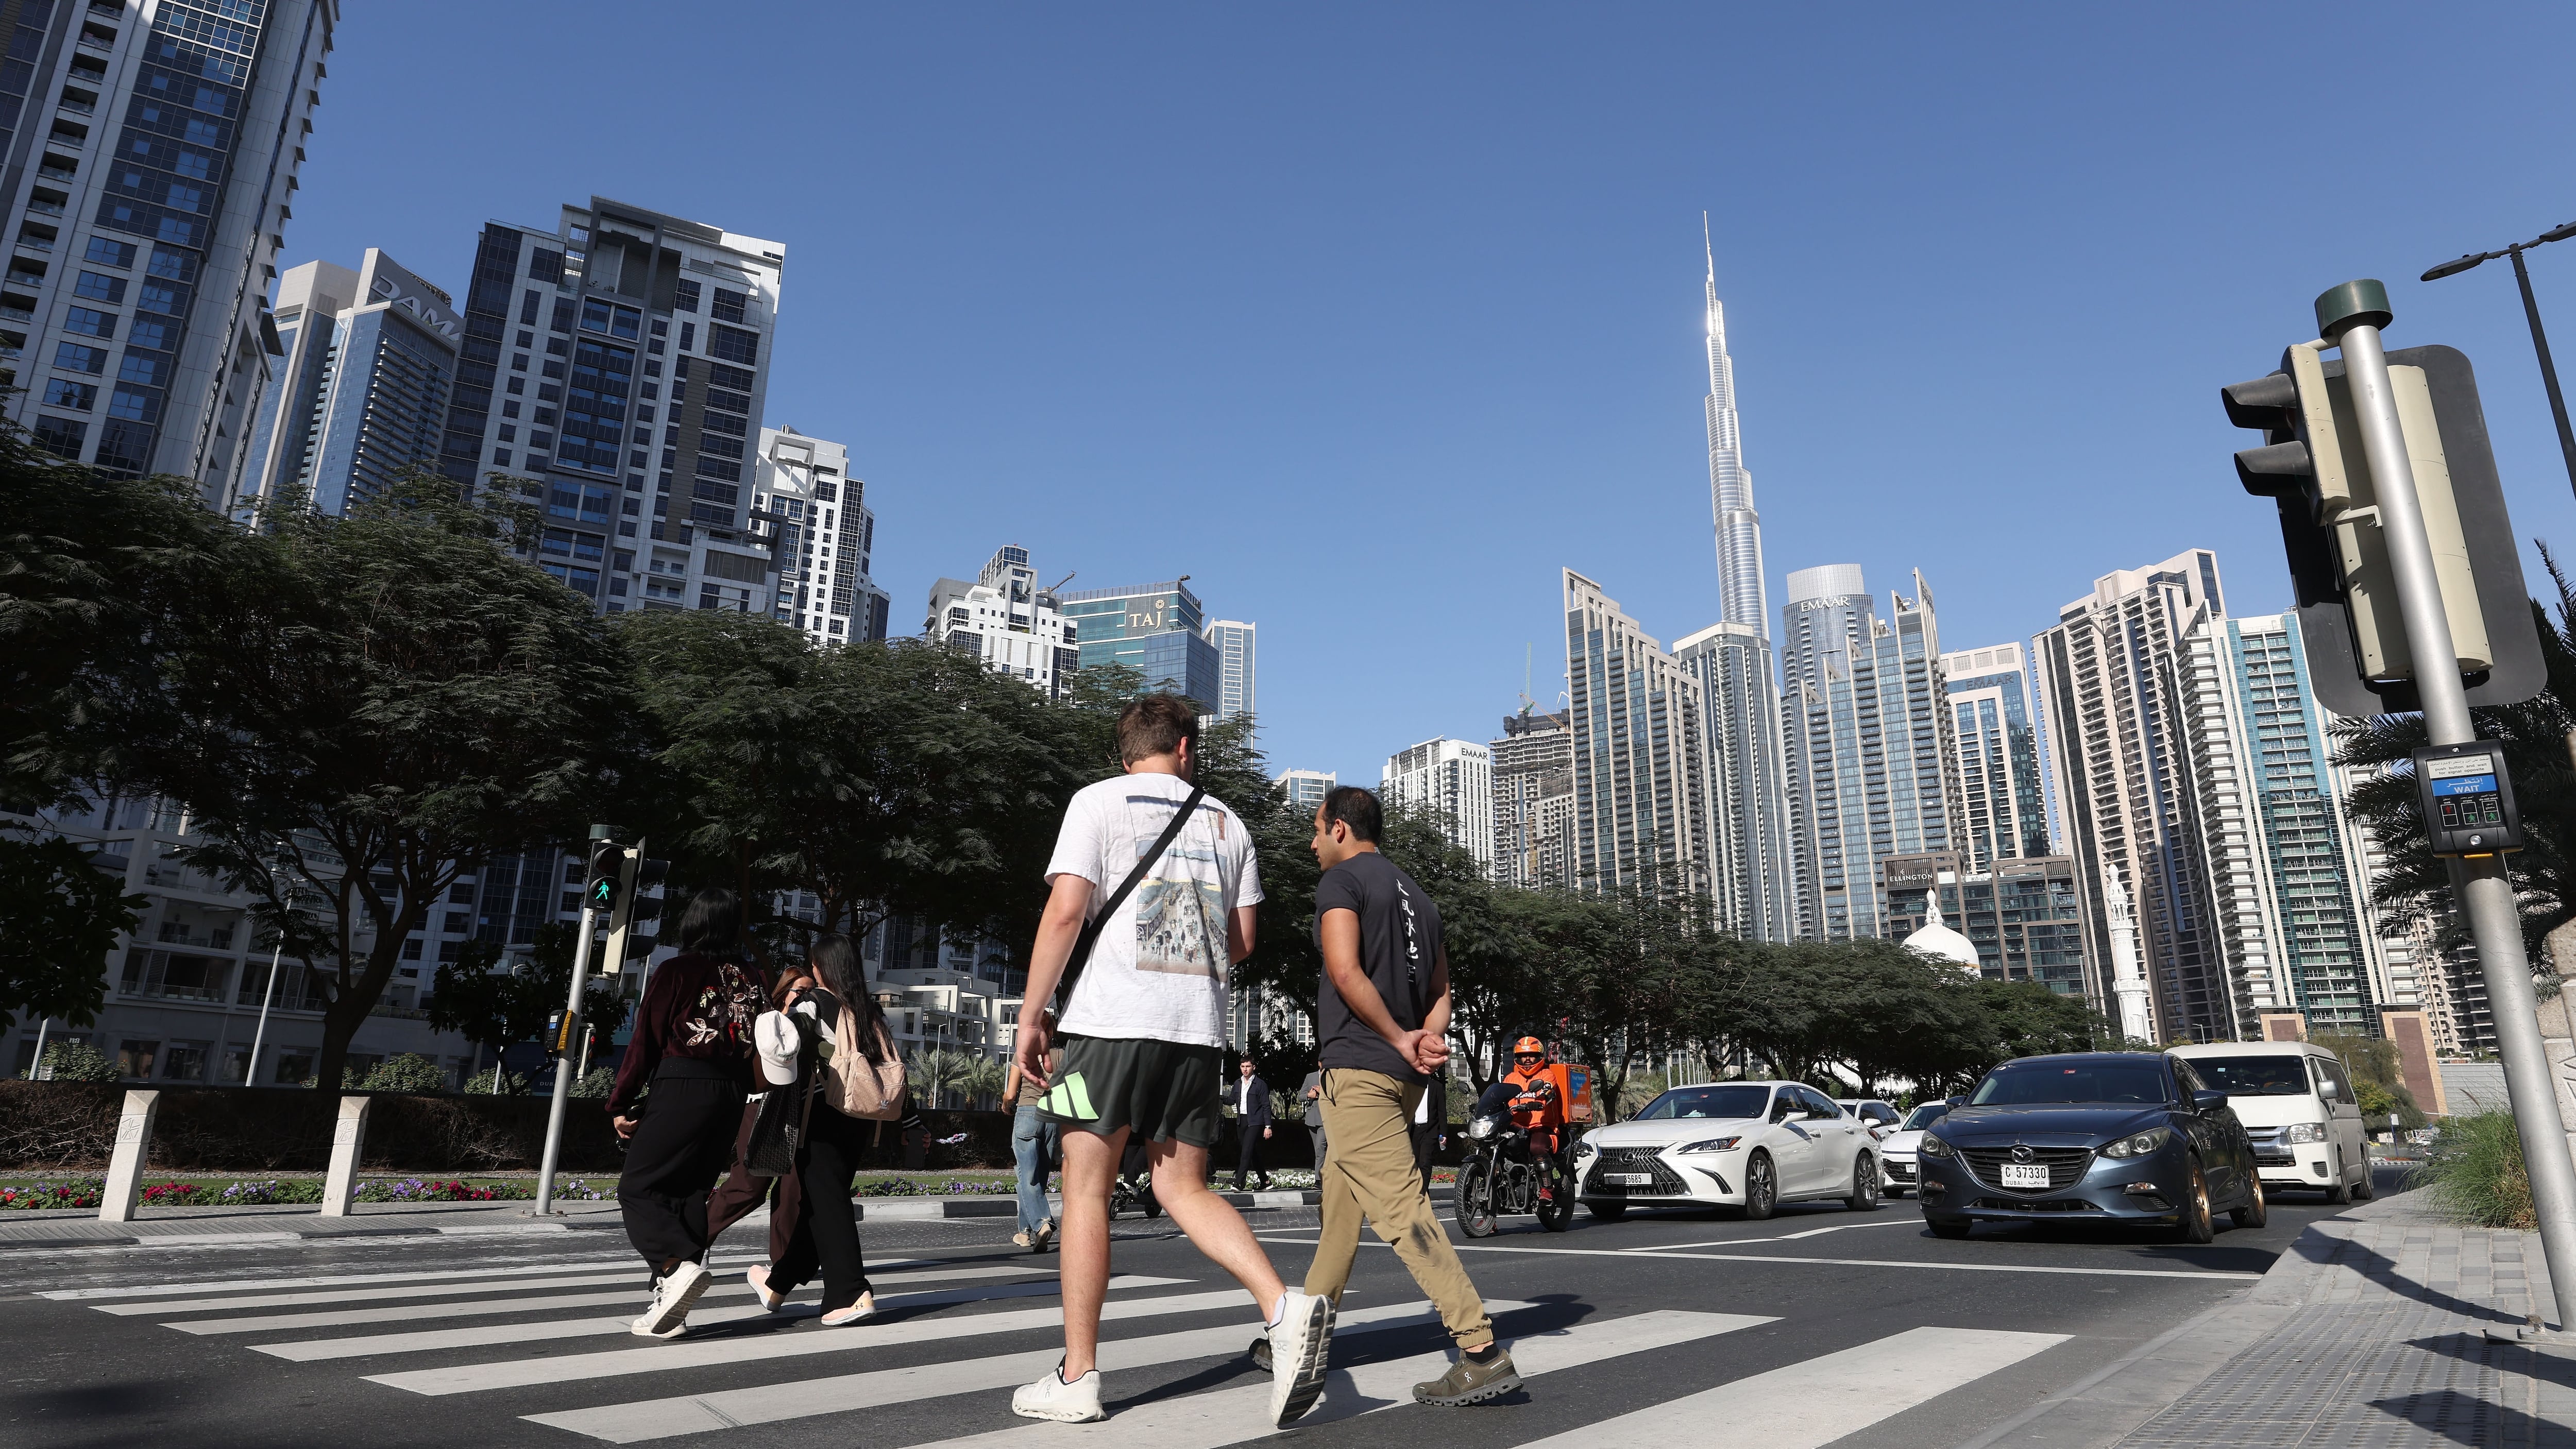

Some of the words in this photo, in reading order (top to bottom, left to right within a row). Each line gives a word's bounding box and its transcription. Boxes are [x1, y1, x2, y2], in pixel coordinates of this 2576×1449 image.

[371, 275, 460, 342] DAM
[1801, 596, 1850, 612] EMAAR
[1129, 611, 1162, 629] TAJ
[1966, 674, 2014, 690] EMAAR
[1461, 747, 1488, 760] EMAAR
[2454, 785, 2479, 793] WAIT
[1889, 873, 1933, 882] ELLINGTON
[1623, 1174, 1642, 1183] 35685
[2005, 1167, 2011, 1178] C
[2016, 1167, 2046, 1179] 57330
